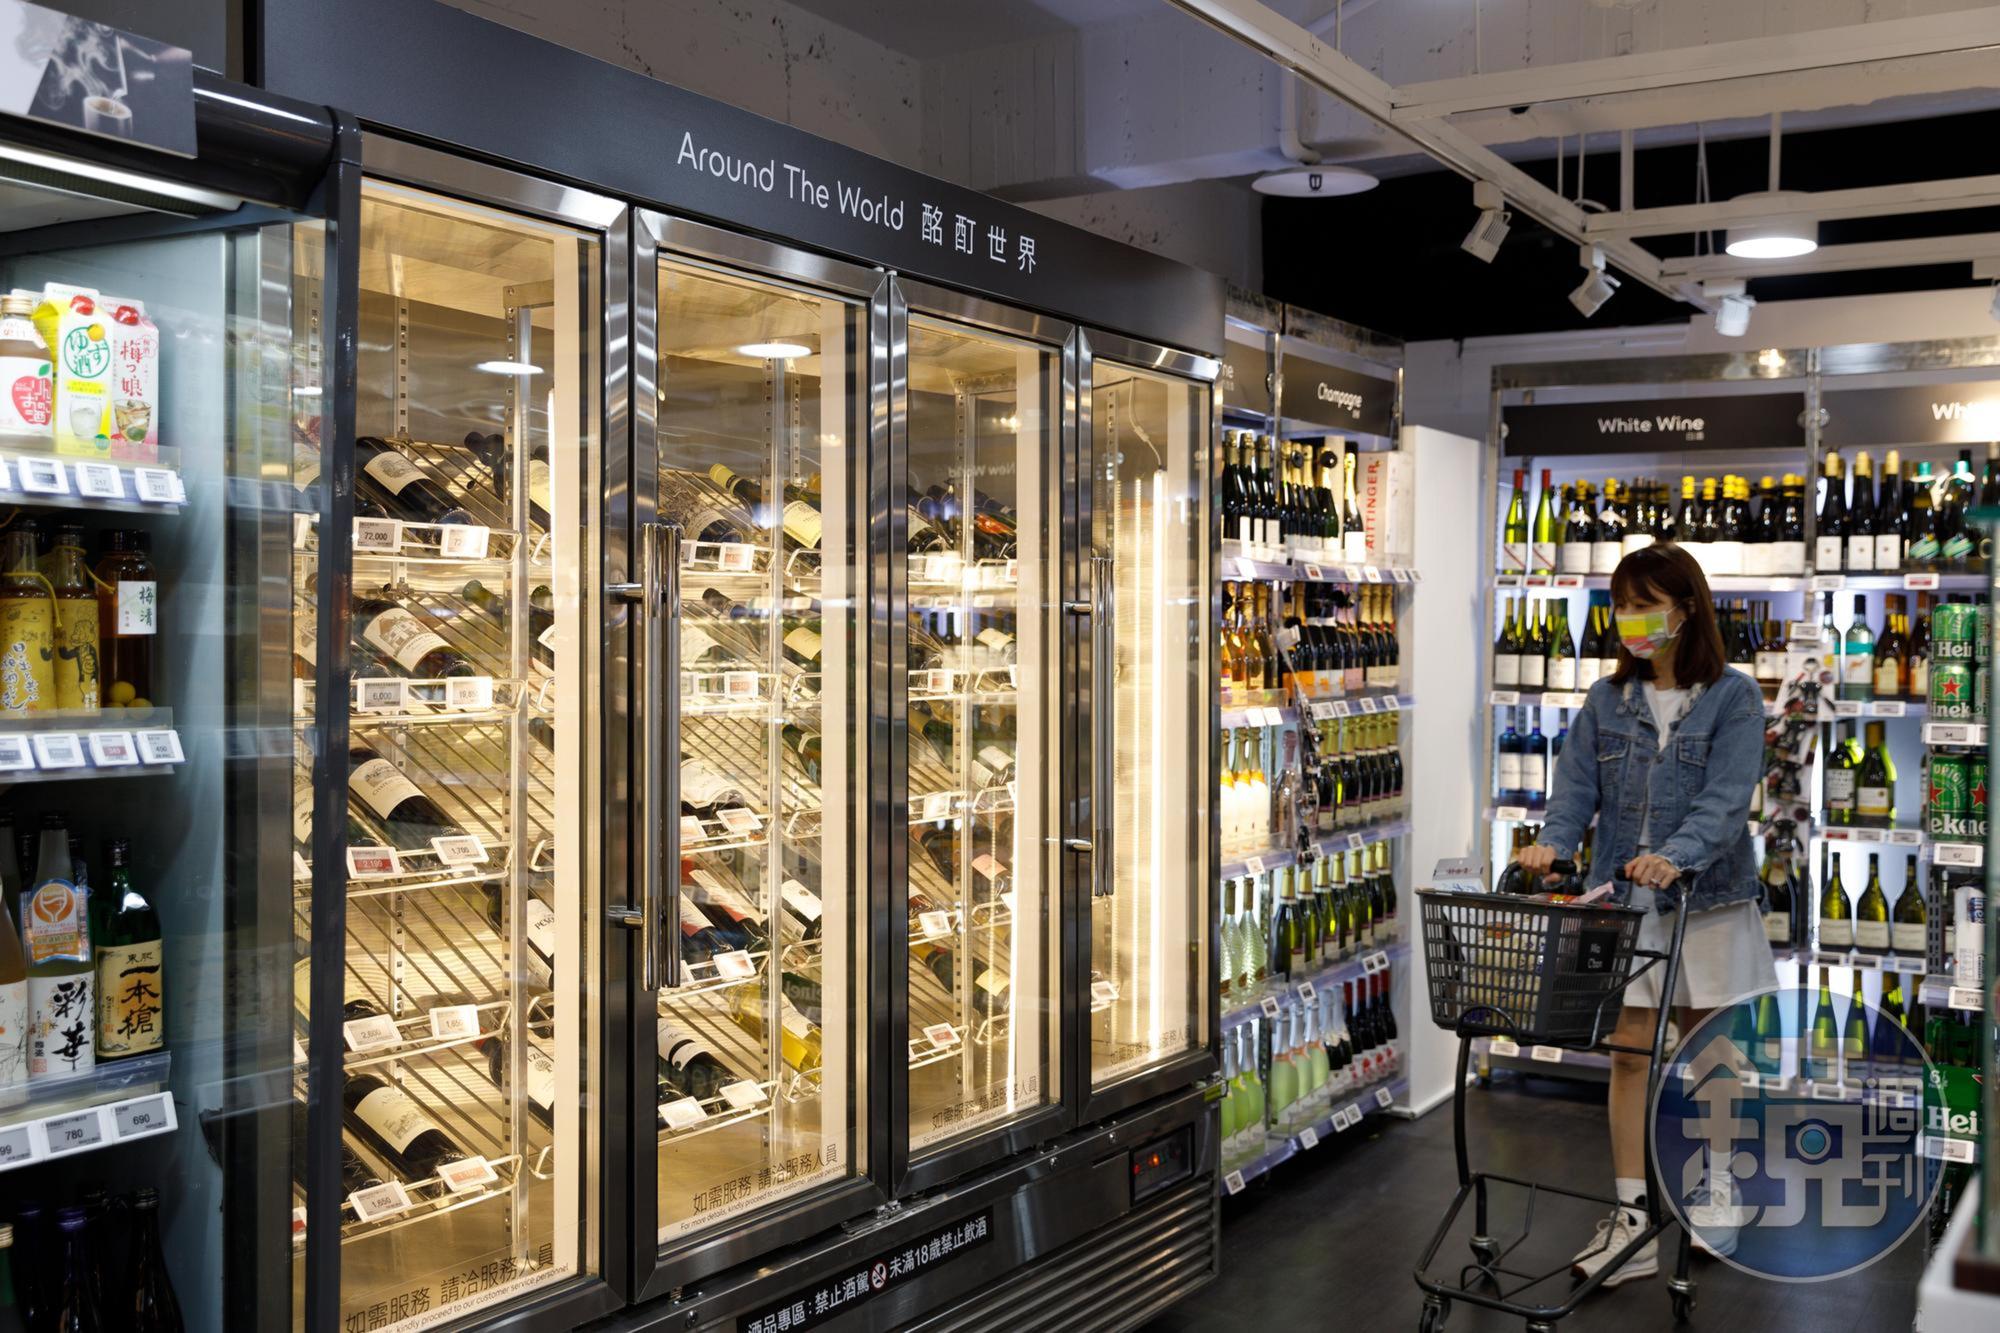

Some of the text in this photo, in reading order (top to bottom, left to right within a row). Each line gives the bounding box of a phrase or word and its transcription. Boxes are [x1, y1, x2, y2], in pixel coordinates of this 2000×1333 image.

[677, 131, 904, 230] Around The World
[921, 202, 1036, 274] 酩酊世界
[1317, 382, 1362, 411] Champagne
[1597, 414, 1704, 433] White Wine
[1365, 463, 1379, 551] AITTINGER
[65, 1128, 84, 1141] 780
[132, 1113, 150, 1126] 690
[1926, 1105, 1979, 1136] Hei
[693, 1142, 838, 1217] 如需服務 請洽服務人員
[889, 1216, 987, 1279] 未滿18歲禁止飲酒
[345, 1243, 554, 1333] 如需服務 請洽服務人員
[476, 1287, 511, 1306] customer
[511, 1278, 536, 1294] service
